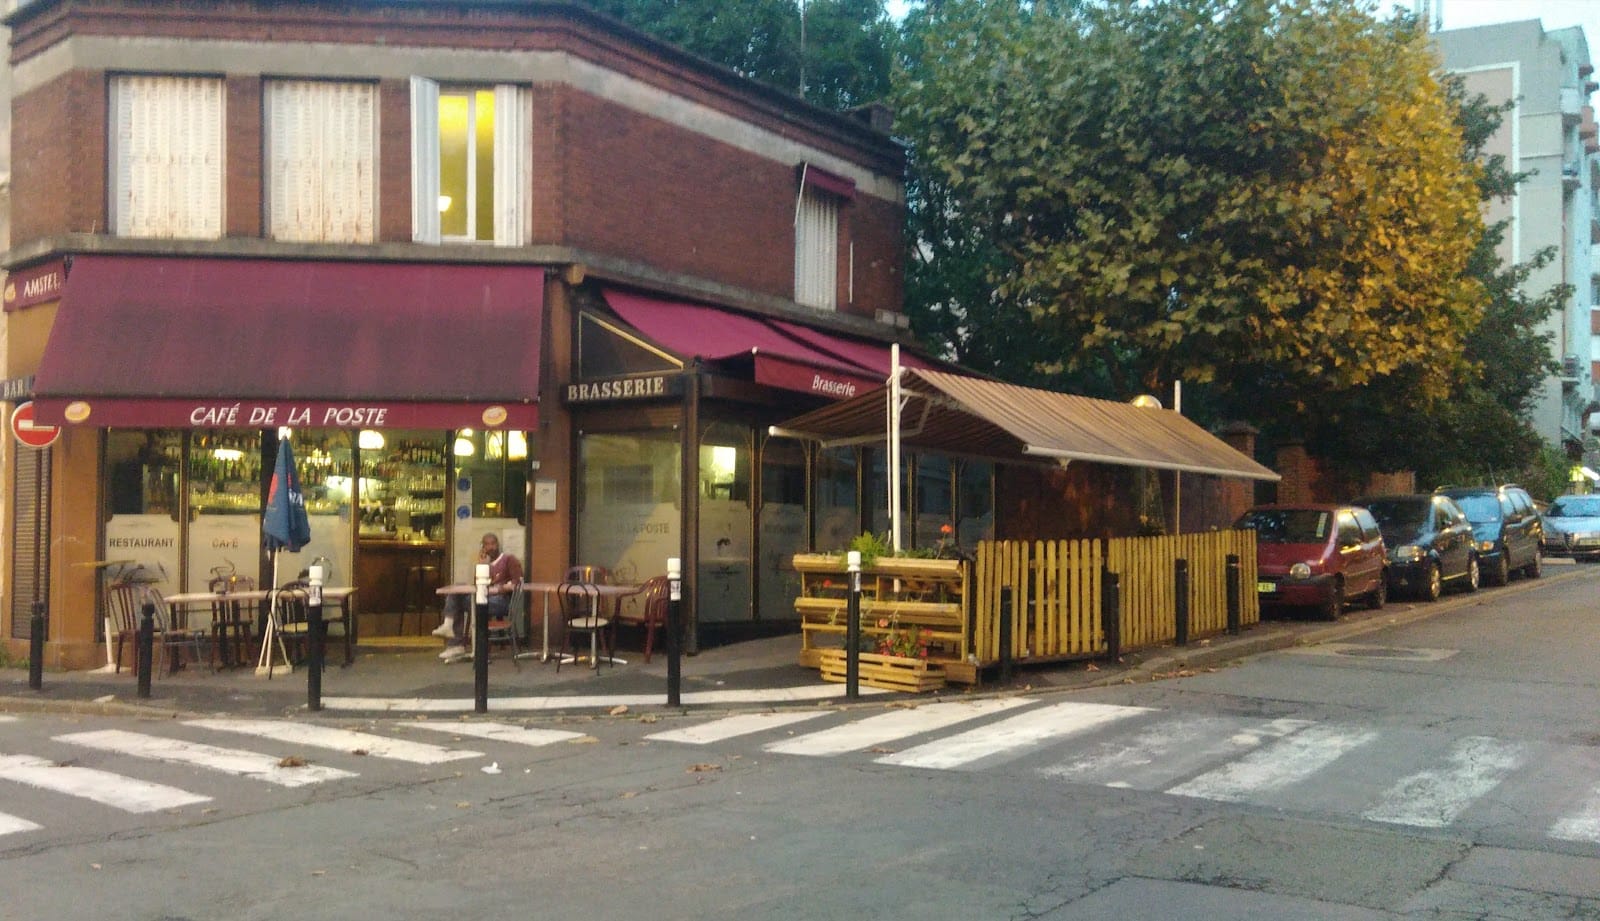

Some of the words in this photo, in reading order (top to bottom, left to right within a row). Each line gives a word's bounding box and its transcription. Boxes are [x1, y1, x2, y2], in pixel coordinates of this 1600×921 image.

[24, 272, 60, 298] AMSTEL
[3, 379, 24, 399] BAR
[567, 377, 664, 402] BRASSERIE
[811, 374, 856, 398] Brasserie
[190, 402, 240, 425] CAFÉ
[248, 406, 278, 425] DE
[287, 406, 311, 425] LA
[323, 407, 388, 425] POSTE
[109, 538, 175, 548] RESTAURANT
